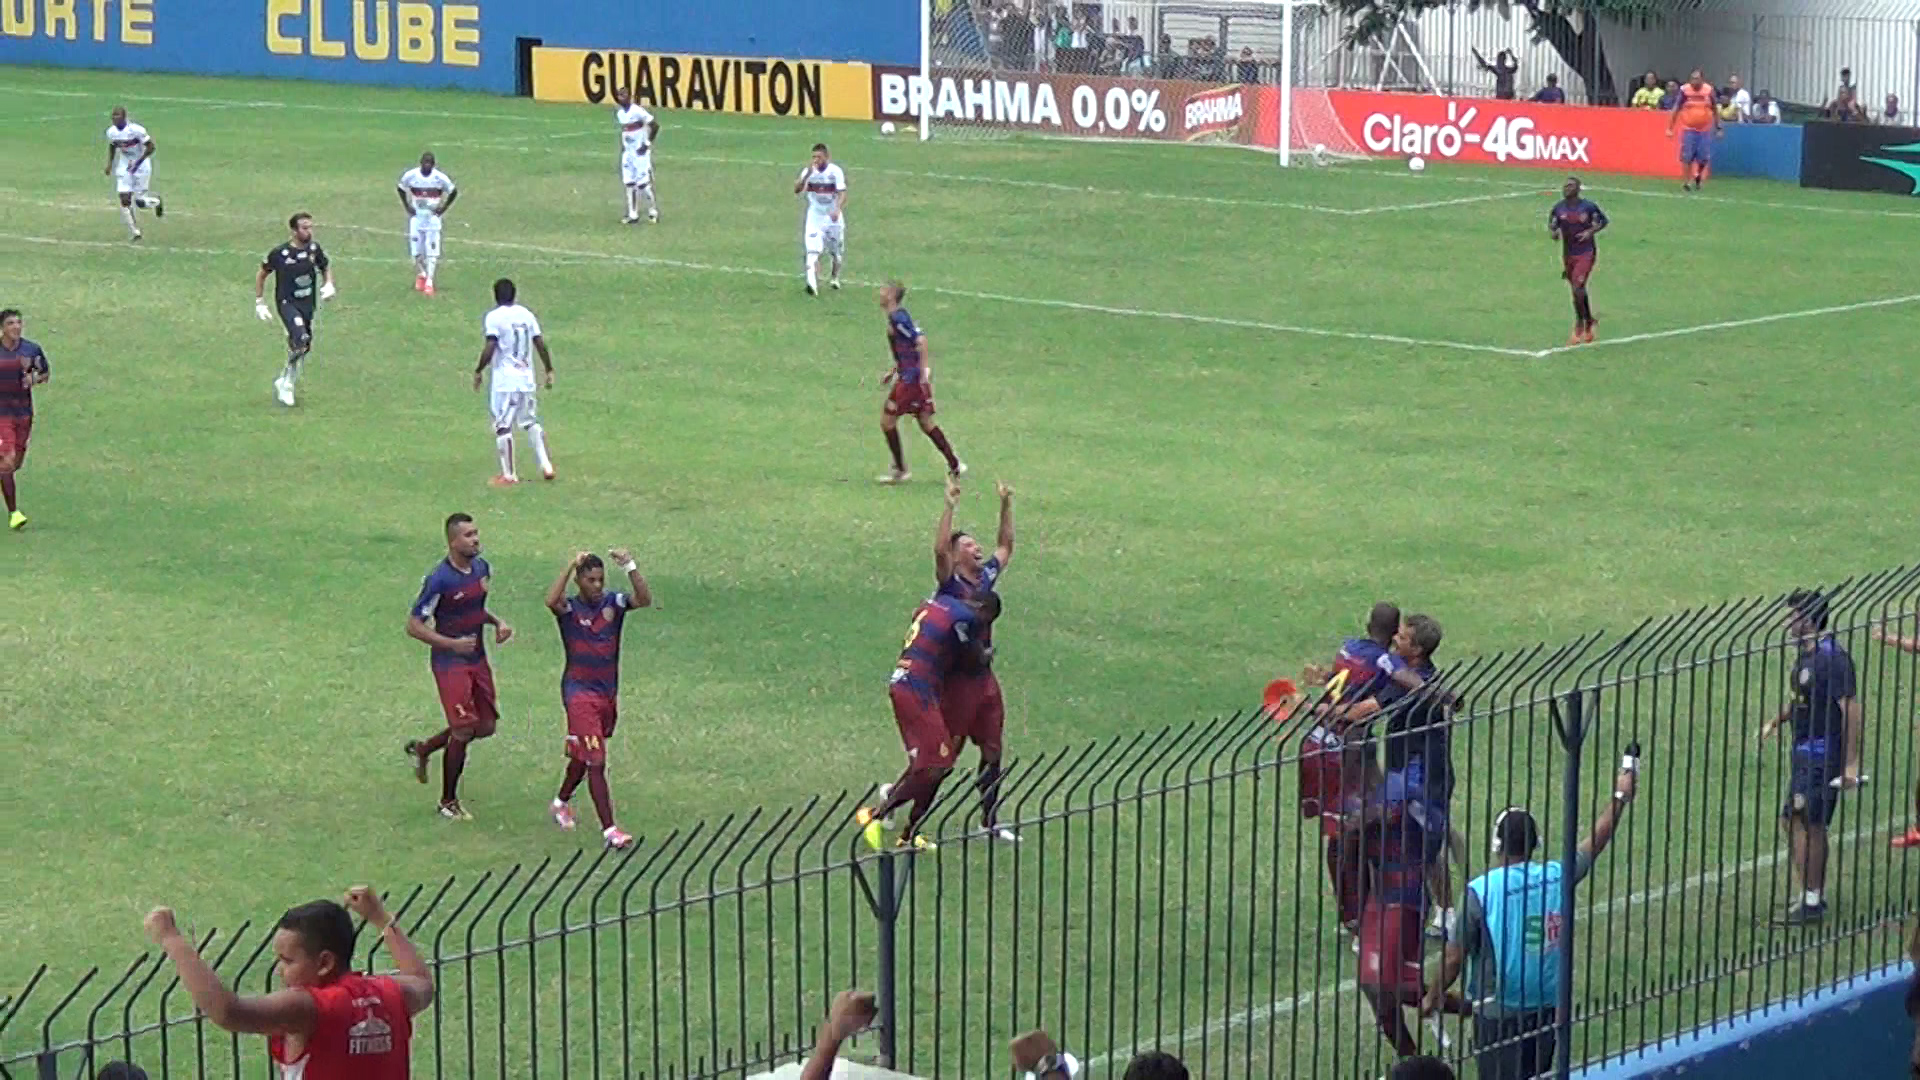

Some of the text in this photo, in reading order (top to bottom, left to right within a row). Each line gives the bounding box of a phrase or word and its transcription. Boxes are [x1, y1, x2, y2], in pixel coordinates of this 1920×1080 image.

[266, 0, 480, 67] CLUBE
[582, 51, 822, 117] GUARAVITON
[880, 73, 1166, 134] BRAHMA 0,0%
[1184, 91, 1243, 130] BRAHMA
[1363, 112, 1462, 157] Claro
